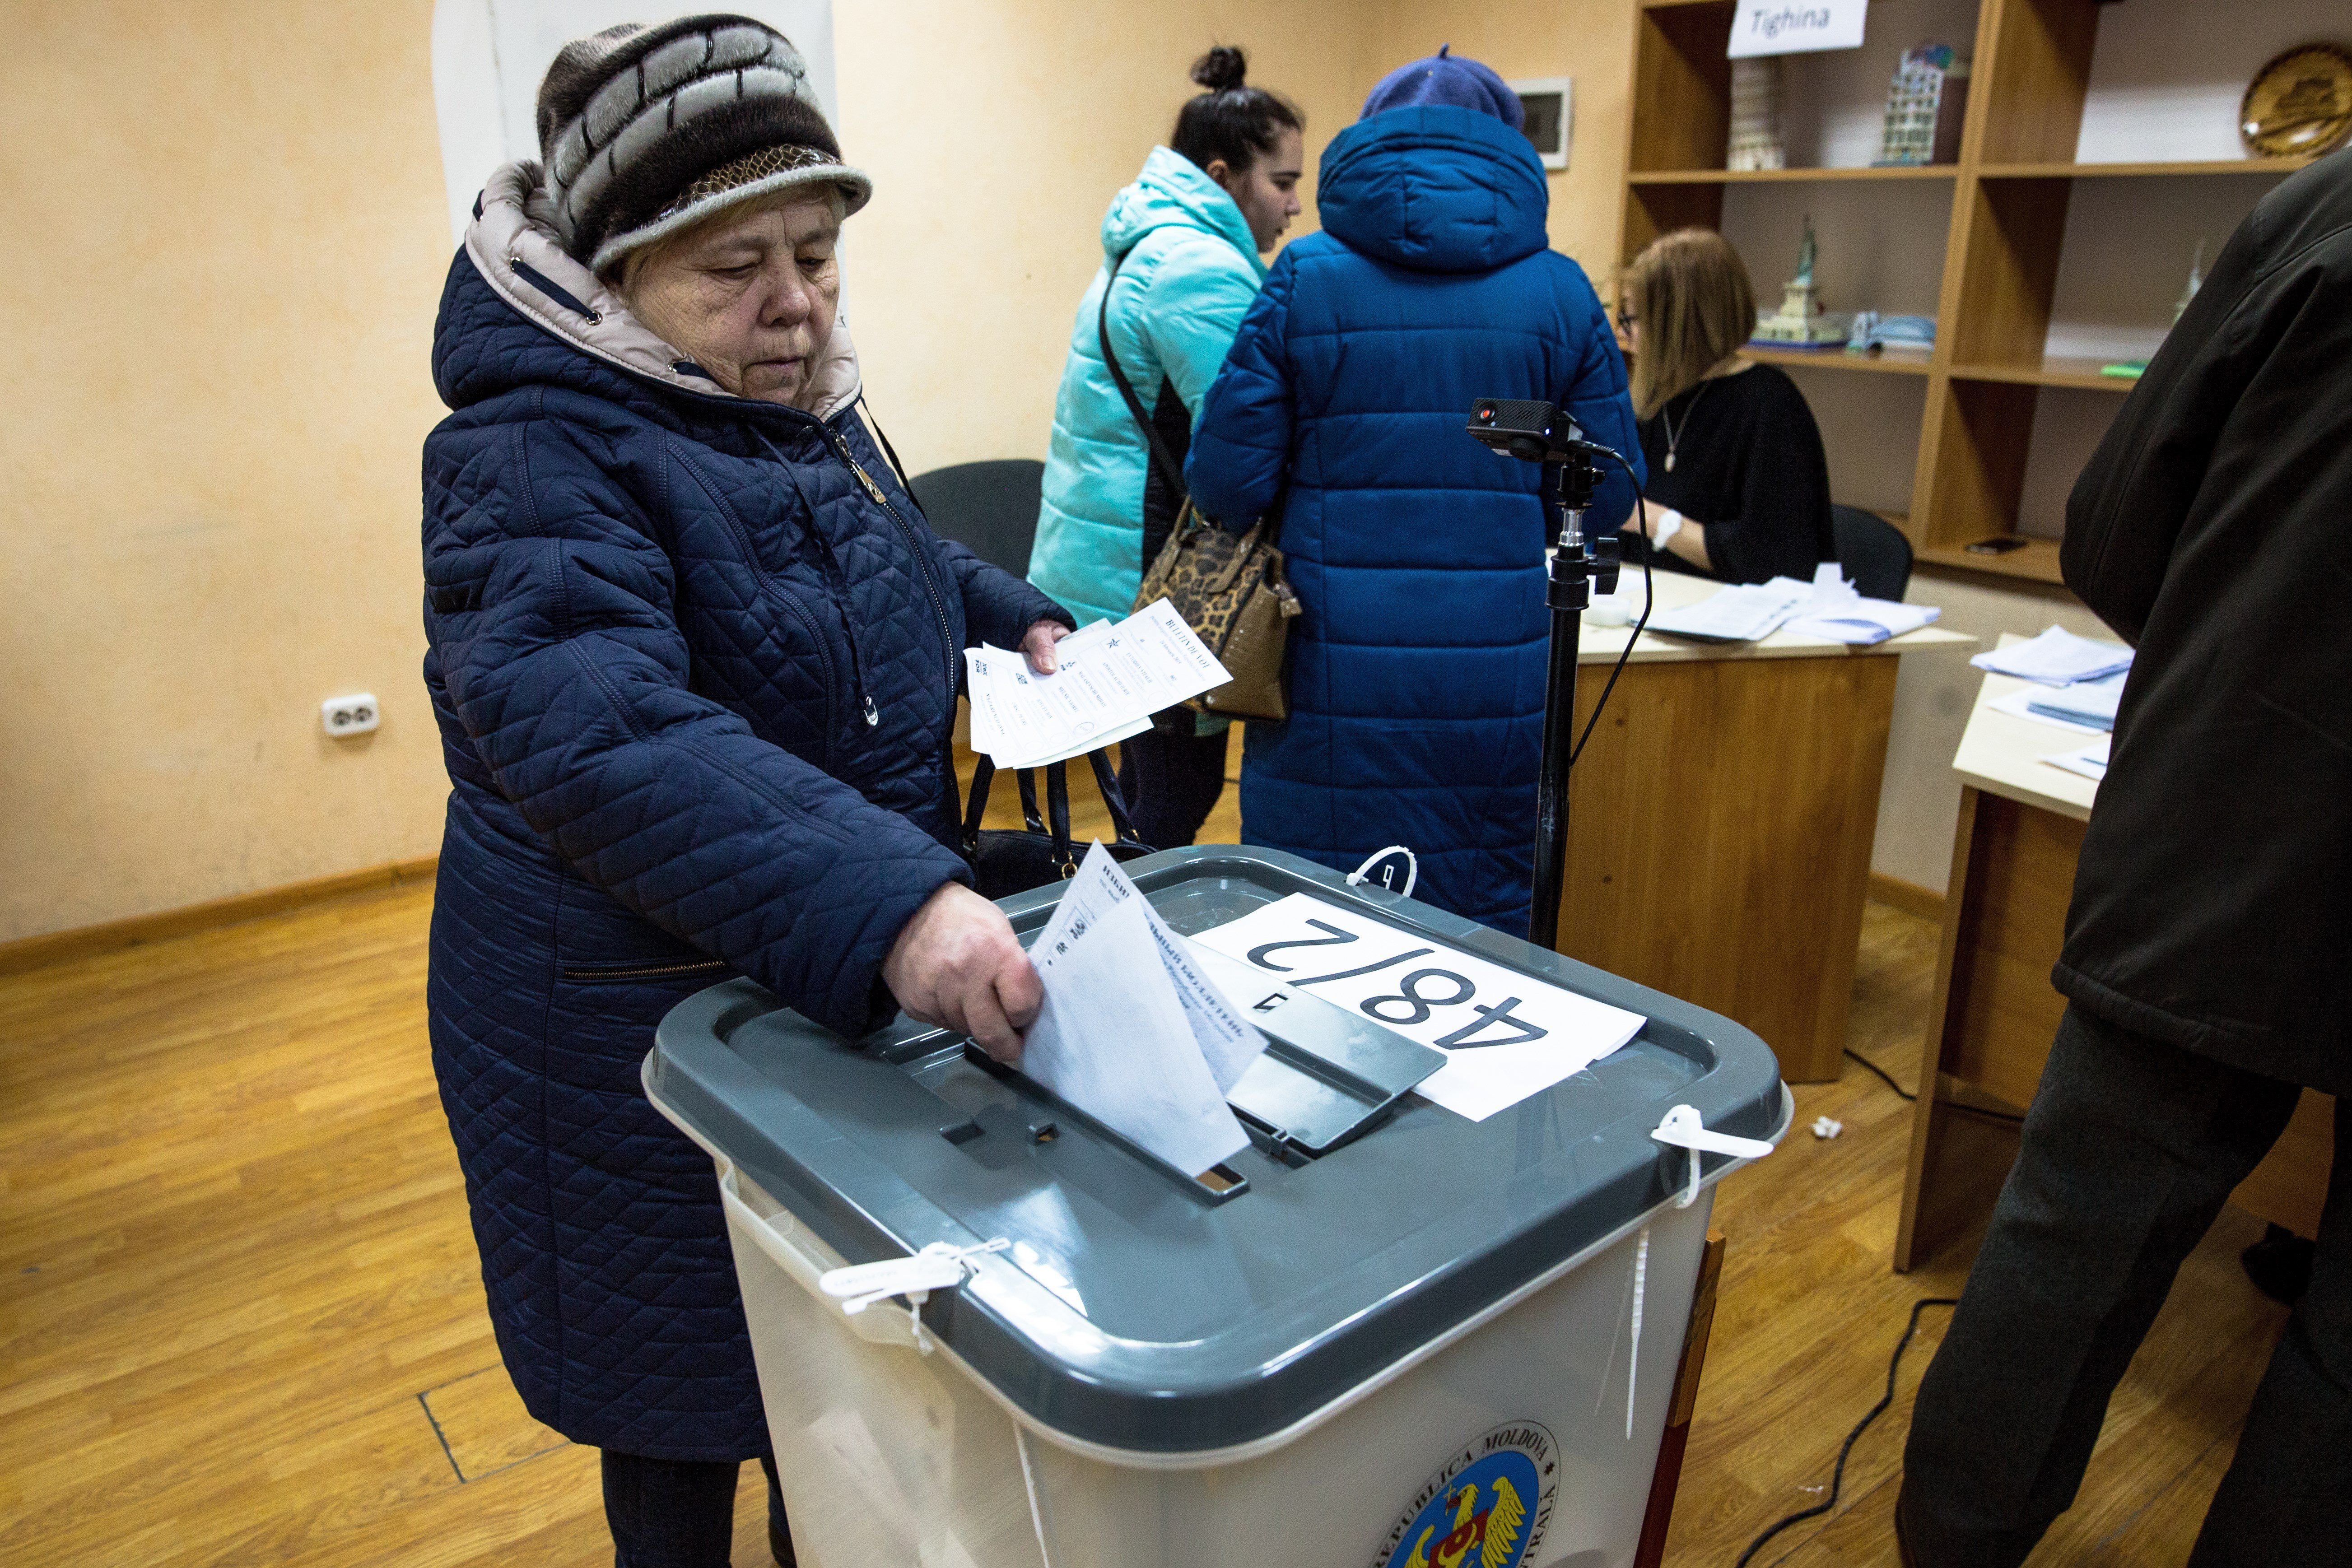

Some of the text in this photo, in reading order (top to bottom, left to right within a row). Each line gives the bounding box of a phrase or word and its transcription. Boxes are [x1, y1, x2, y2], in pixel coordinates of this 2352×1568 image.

[1750, 5, 1830, 40] Tighina
[1165, 619, 1211, 669] BULETIN DE VOT
[1247, 919, 1548, 1050] 48/2
[1373, 1429, 1548, 1568] REPUBLICA MOLDOVA
